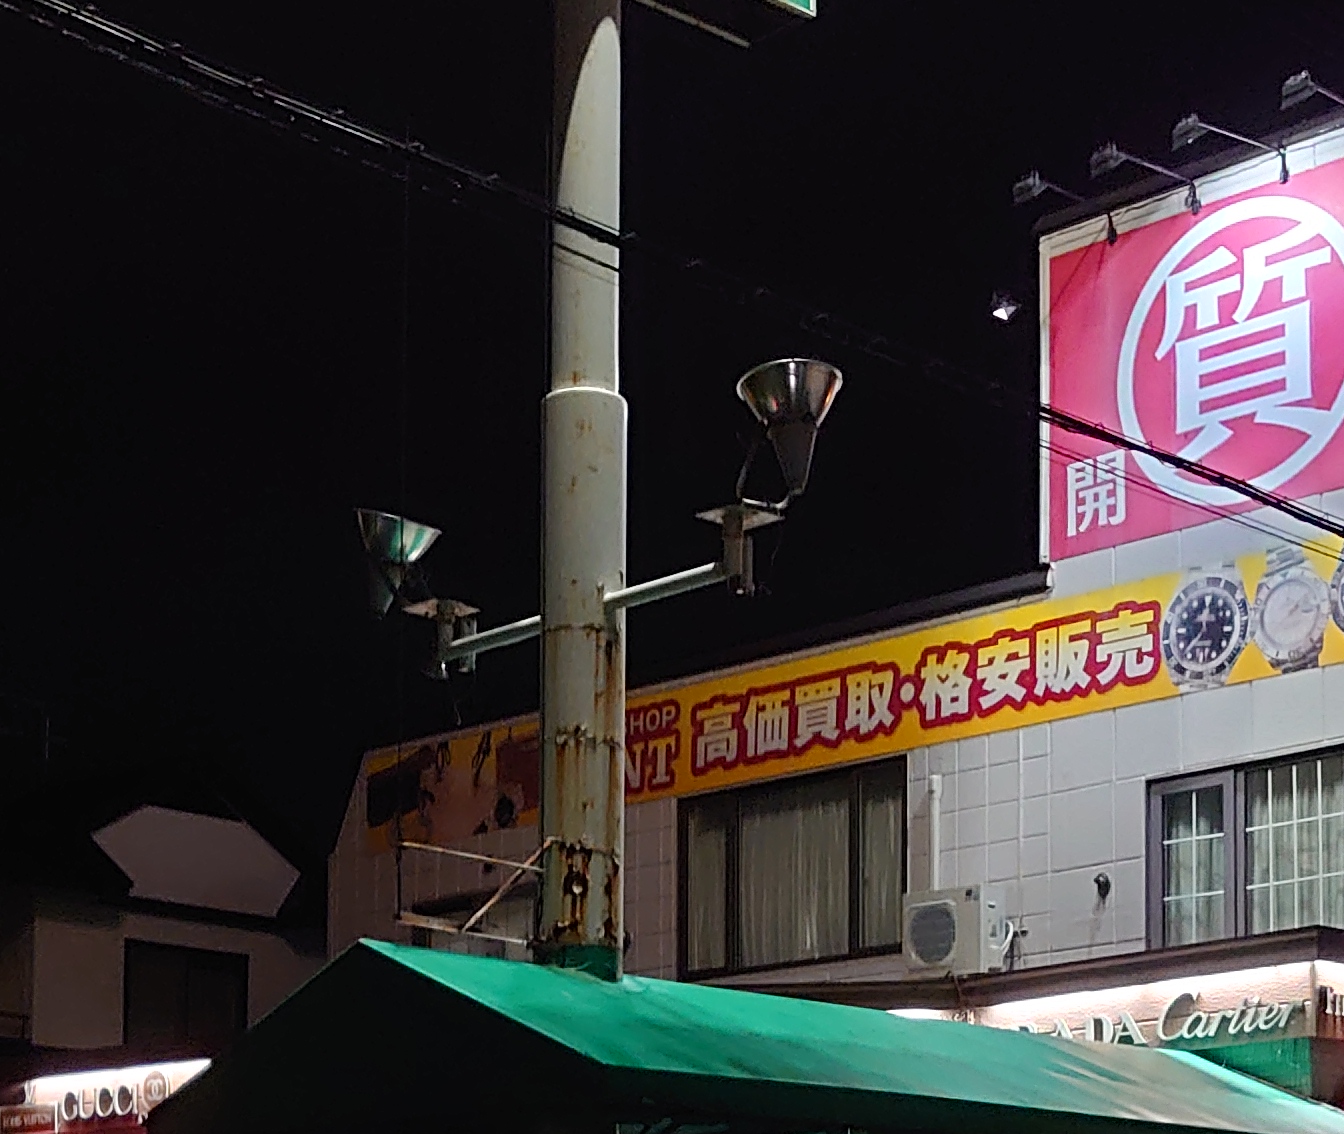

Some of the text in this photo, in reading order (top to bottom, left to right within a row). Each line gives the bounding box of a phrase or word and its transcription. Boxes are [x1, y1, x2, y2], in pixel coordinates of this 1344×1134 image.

[1155, 229, 1333, 455] 質
[1066, 453, 1126, 538] 開
[695, 608, 1156, 768] 高価買取・格安販売
[1157, 992, 1303, 1041] Cartier
[60, 1083, 139, 1122] GUCCI
